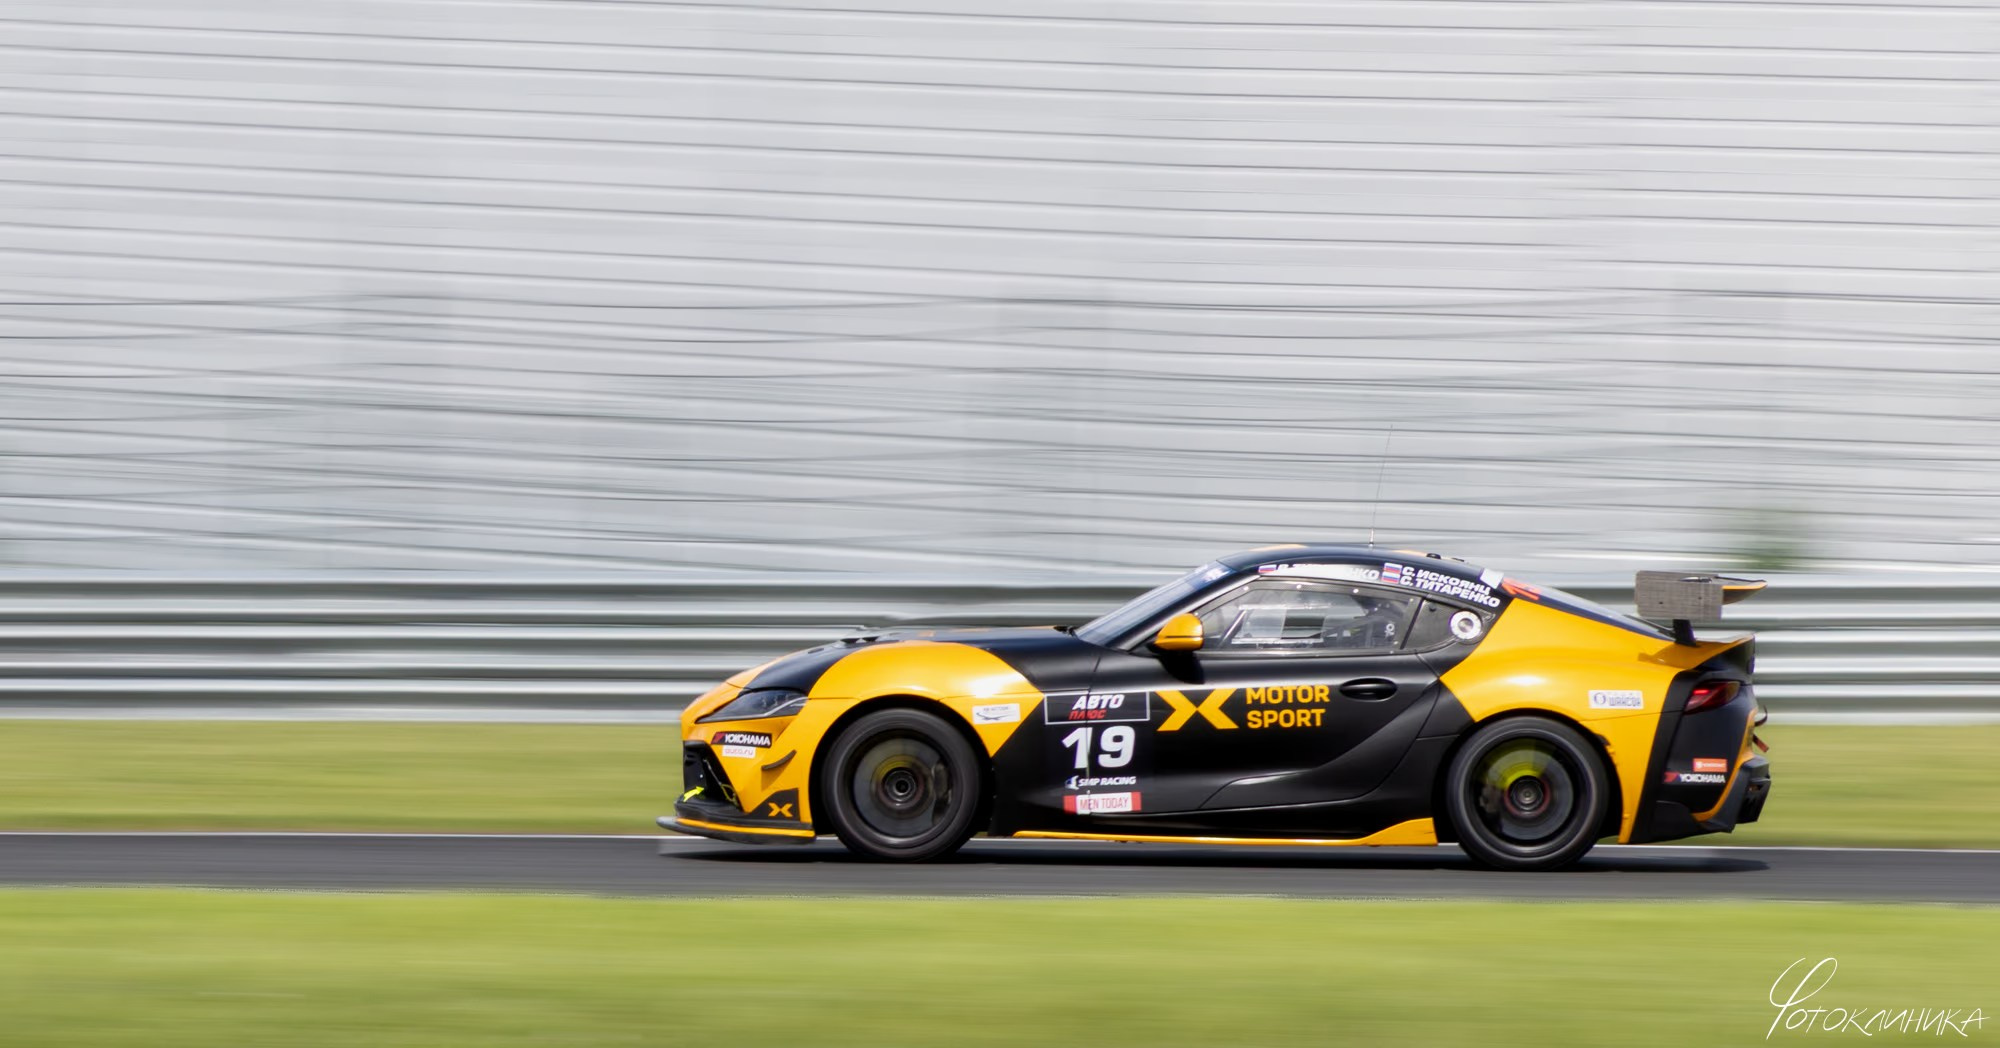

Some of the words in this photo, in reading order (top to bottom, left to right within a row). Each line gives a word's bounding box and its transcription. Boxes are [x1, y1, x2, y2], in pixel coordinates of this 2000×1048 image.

[1402, 566, 1416, 577] С.
[1416, 569, 1491, 596] ИСКОЯНЦ
[1400, 576, 1414, 587] С.
[1414, 579, 1501, 608] ТИТАРЕНКО
[1071, 694, 1125, 710] АВТО
[1246, 685, 1331, 704] MOTOR
[1247, 709, 1327, 729] SPORT
[725, 733, 771, 746] YOKOHAMA
[1061, 725, 1136, 769] 19
[1078, 777, 1101, 787] SMP
[1100, 776, 1137, 786] RACING
[1679, 773, 1726, 783] YOKOHAMA
[1080, 798, 1099, 811] MEN
[1102, 797, 1129, 809] TODAY
